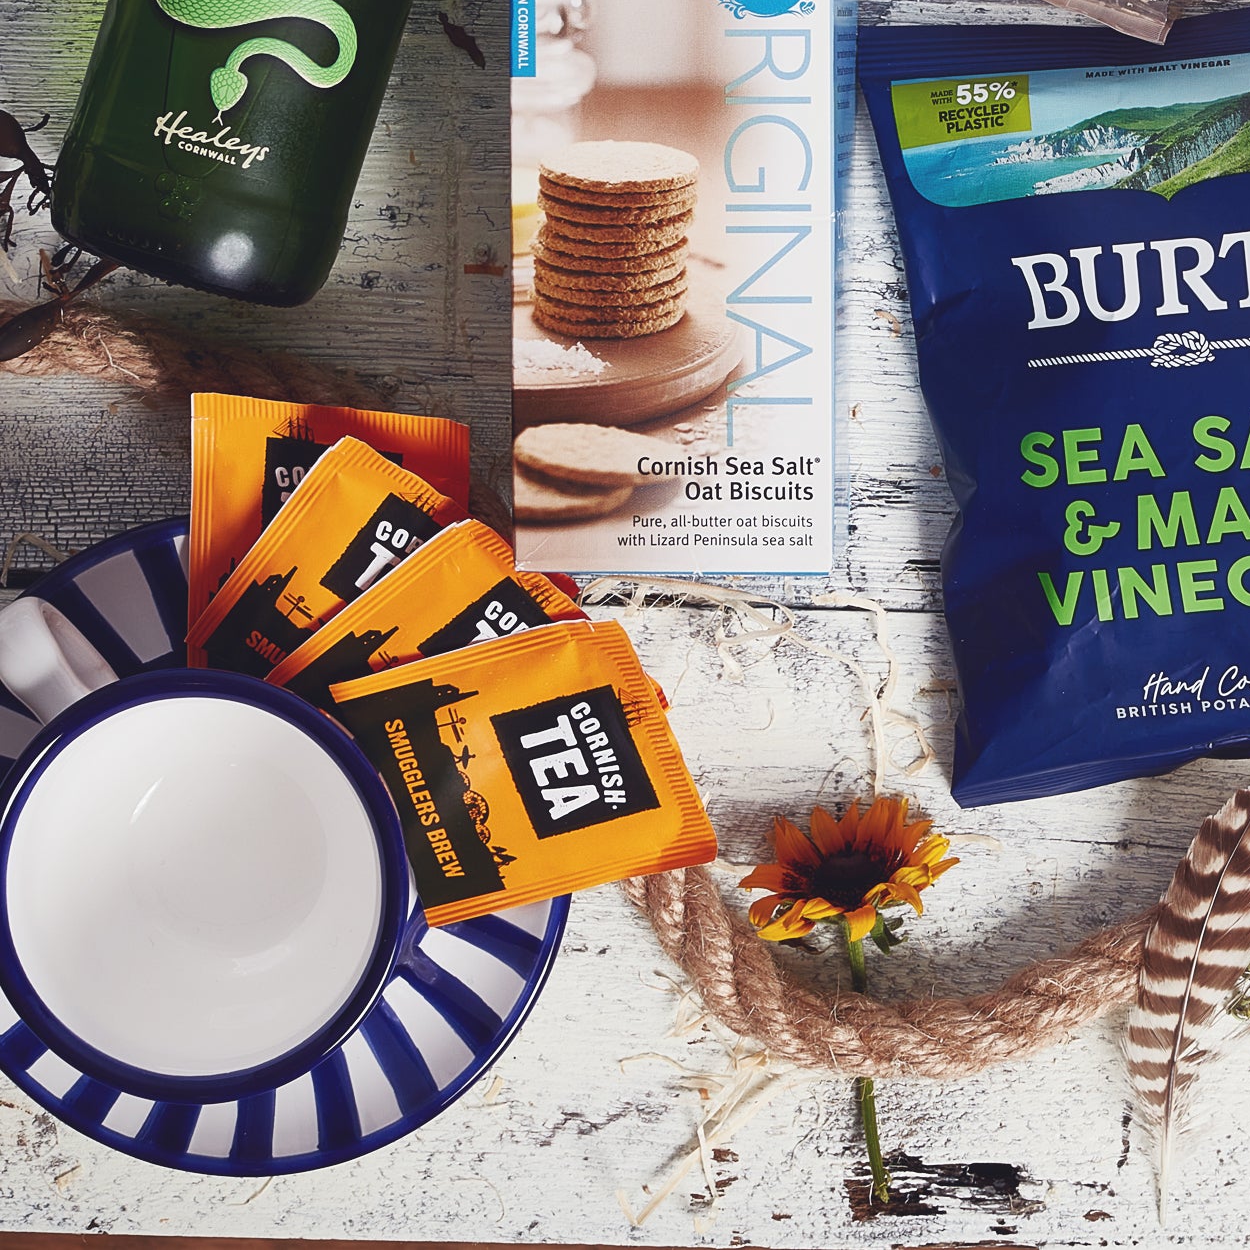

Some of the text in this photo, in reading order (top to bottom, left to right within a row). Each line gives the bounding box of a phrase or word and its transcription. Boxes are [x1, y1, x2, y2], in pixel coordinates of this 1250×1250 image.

[517, 7, 529, 69] CORNWALL
[939, 103, 1010, 122] RECYCLED
[947, 116, 1004, 133] PLASTIC
[154, 111, 269, 168] Healeys
[178, 141, 236, 165] CORNWALL
[637, 456, 718, 476] Cornish
[725, 456, 765, 476] Sea
[1020, 424, 1166, 488] SEA
[685, 481, 814, 501] Oat Biscuits
[632, 514, 813, 529] Pure, all-butter oat biscuits
[1063, 500, 1120, 556] &
[617, 533, 813, 547] with Lizard Peninsula sea salt
[1143, 667, 1210, 701] Hand
[1116, 702, 1192, 719] BRITISH
[519, 715, 602, 821] TEA
[569, 700, 627, 807] CORNISH
[385, 718, 465, 878] SMUGGLERS BREW
